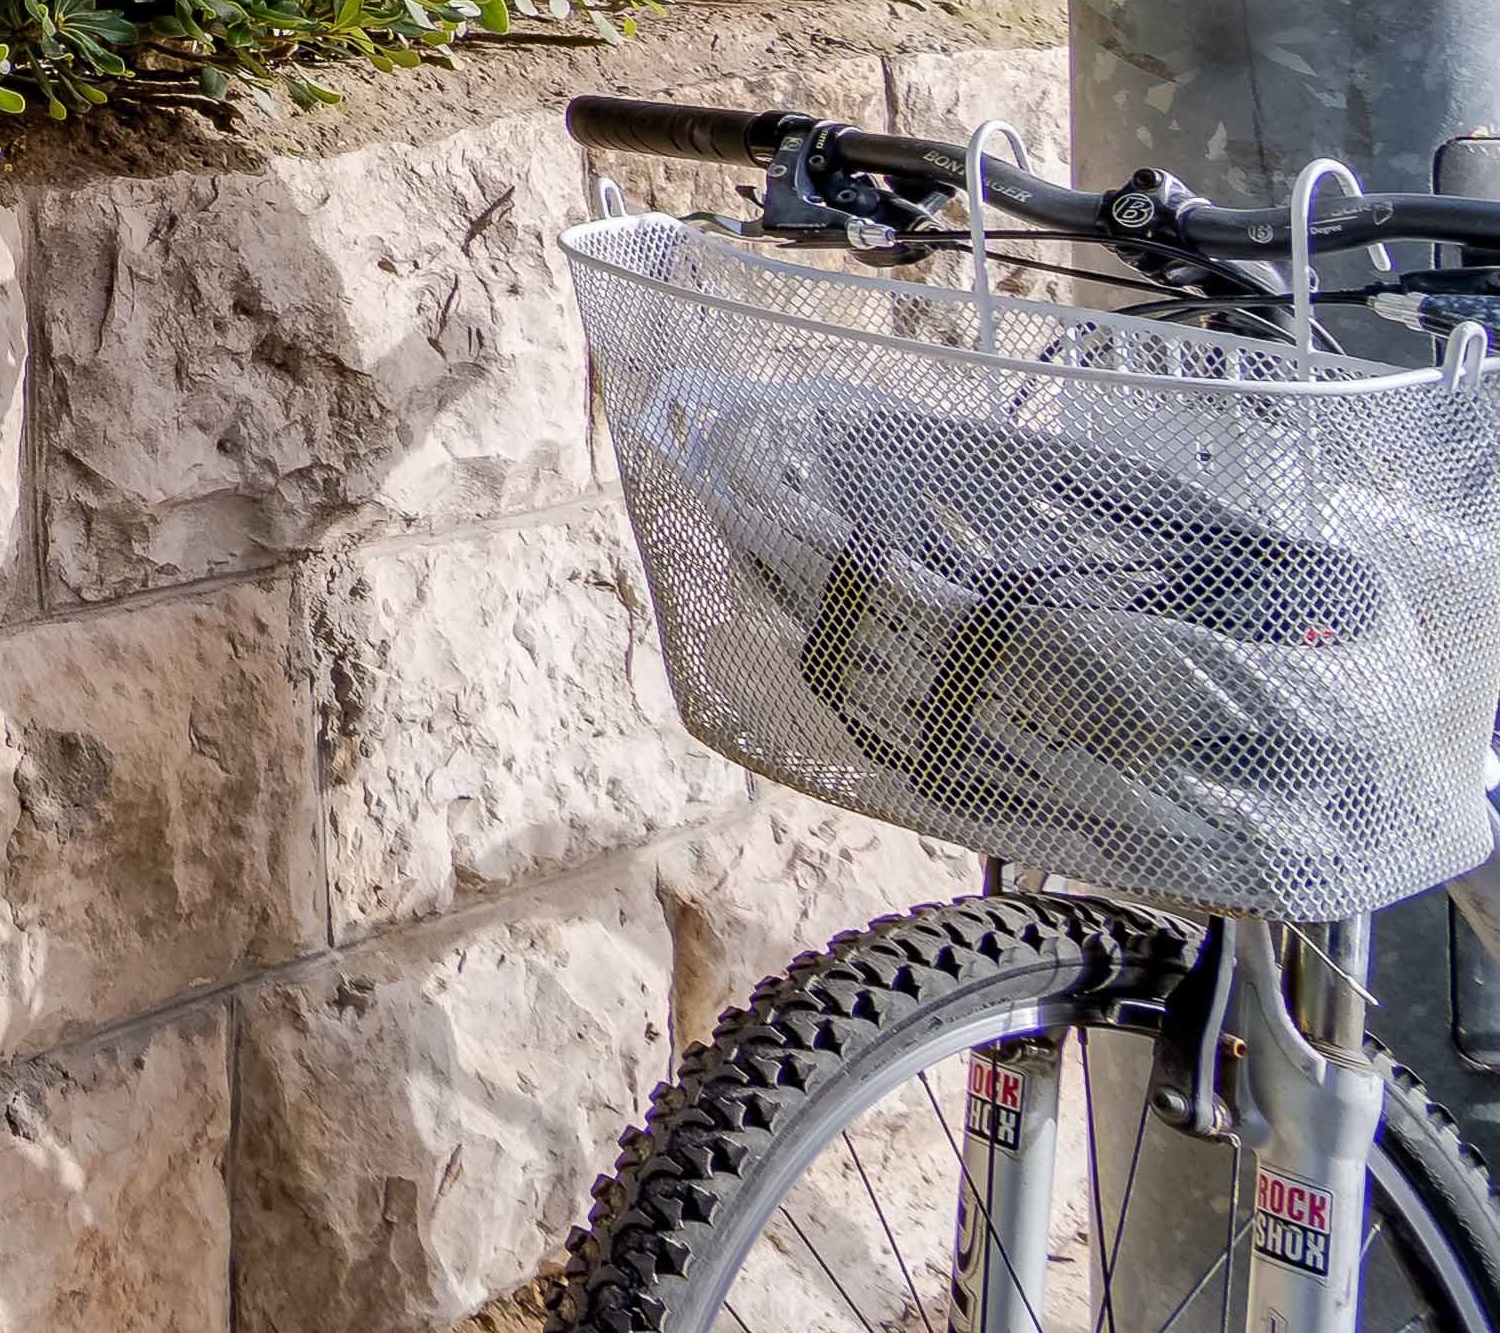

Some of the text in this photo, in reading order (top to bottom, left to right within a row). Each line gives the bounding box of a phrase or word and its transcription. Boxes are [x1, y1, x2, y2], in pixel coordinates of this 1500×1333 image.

[922, 149, 1033, 205] BONGER
[1258, 1173, 1327, 1231] ROCK
[1255, 1209, 1326, 1271] SHOX
